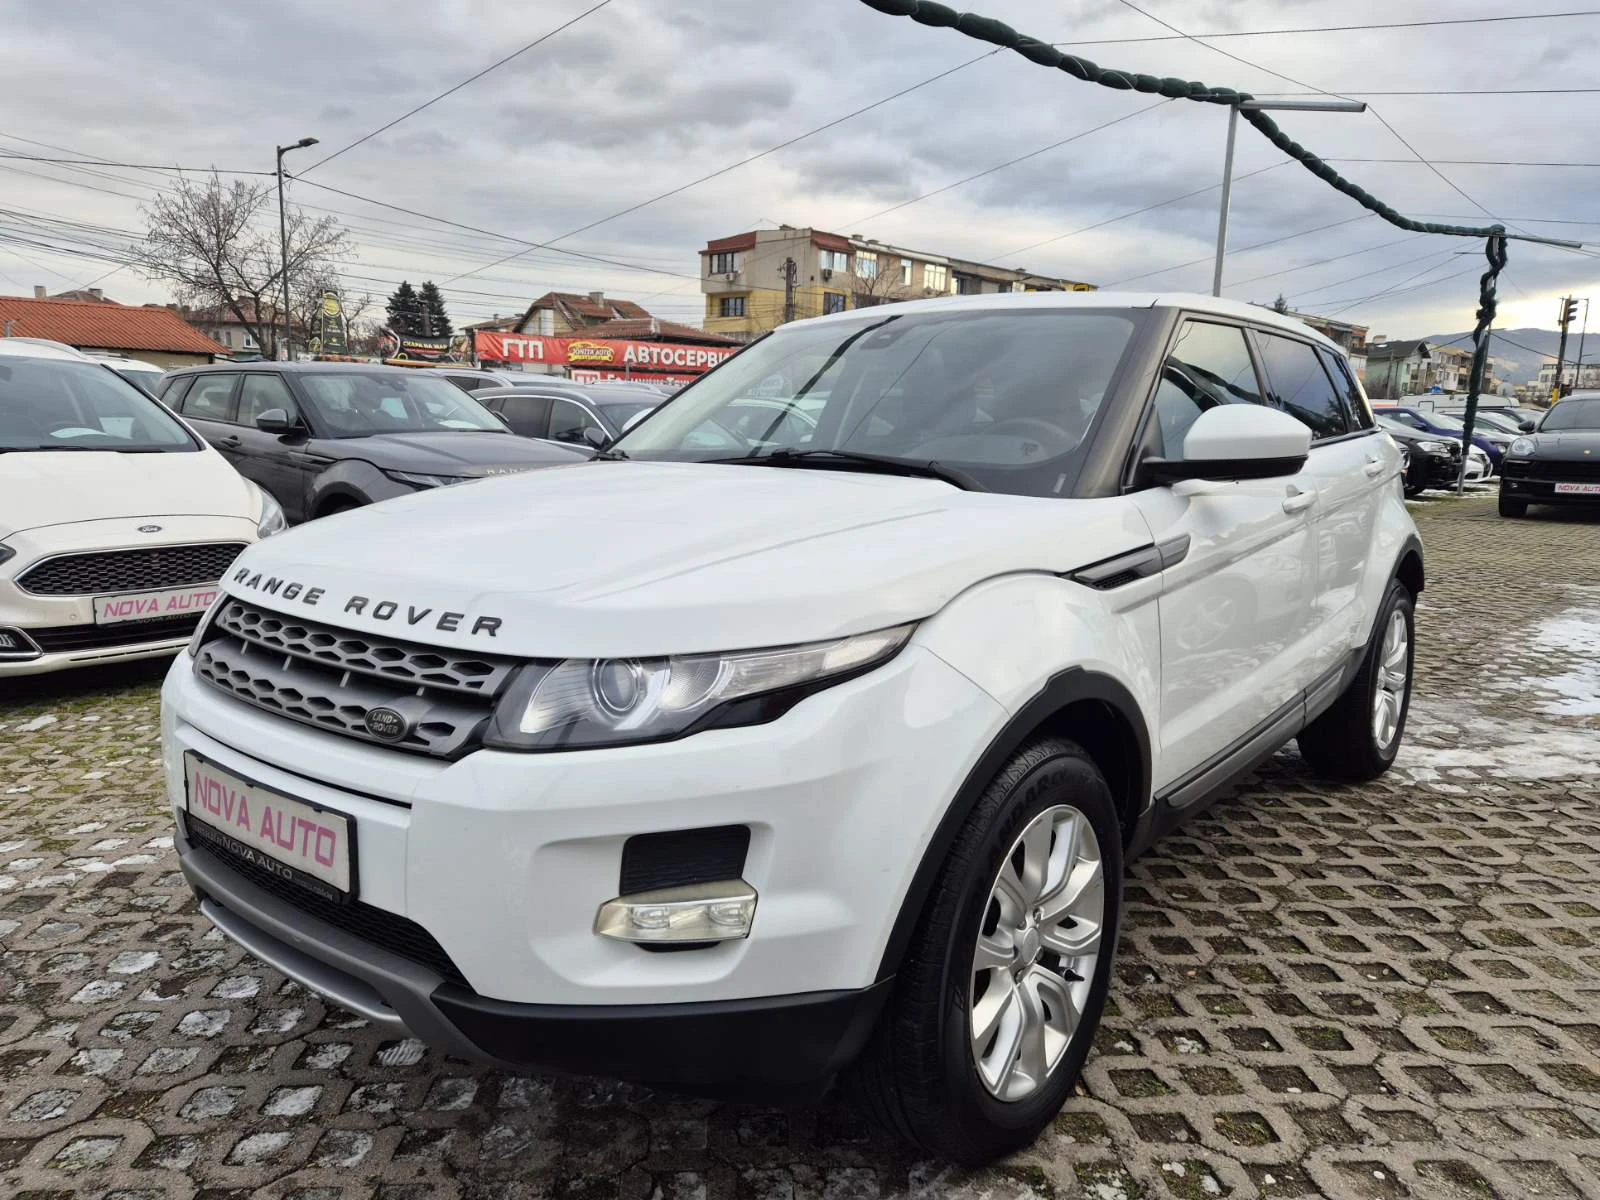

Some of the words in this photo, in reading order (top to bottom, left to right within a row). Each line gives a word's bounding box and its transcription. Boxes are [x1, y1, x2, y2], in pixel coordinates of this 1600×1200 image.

[503, 339, 544, 359] ГТП
[623, 344, 735, 368] АВТОСЕРВИ
[103, 598, 159, 617] NOVA
[166, 591, 217, 611] AUTO
[233, 567, 325, 605] RANGE
[344, 595, 503, 637] ROVER
[372, 712, 394, 724] LAND
[373, 722, 399, 735] ROVER
[195, 771, 252, 832] NOVA
[260, 806, 337, 868] AUTO
[222, 835, 257, 864] NOVA
[258, 856, 293, 880] AUTO
